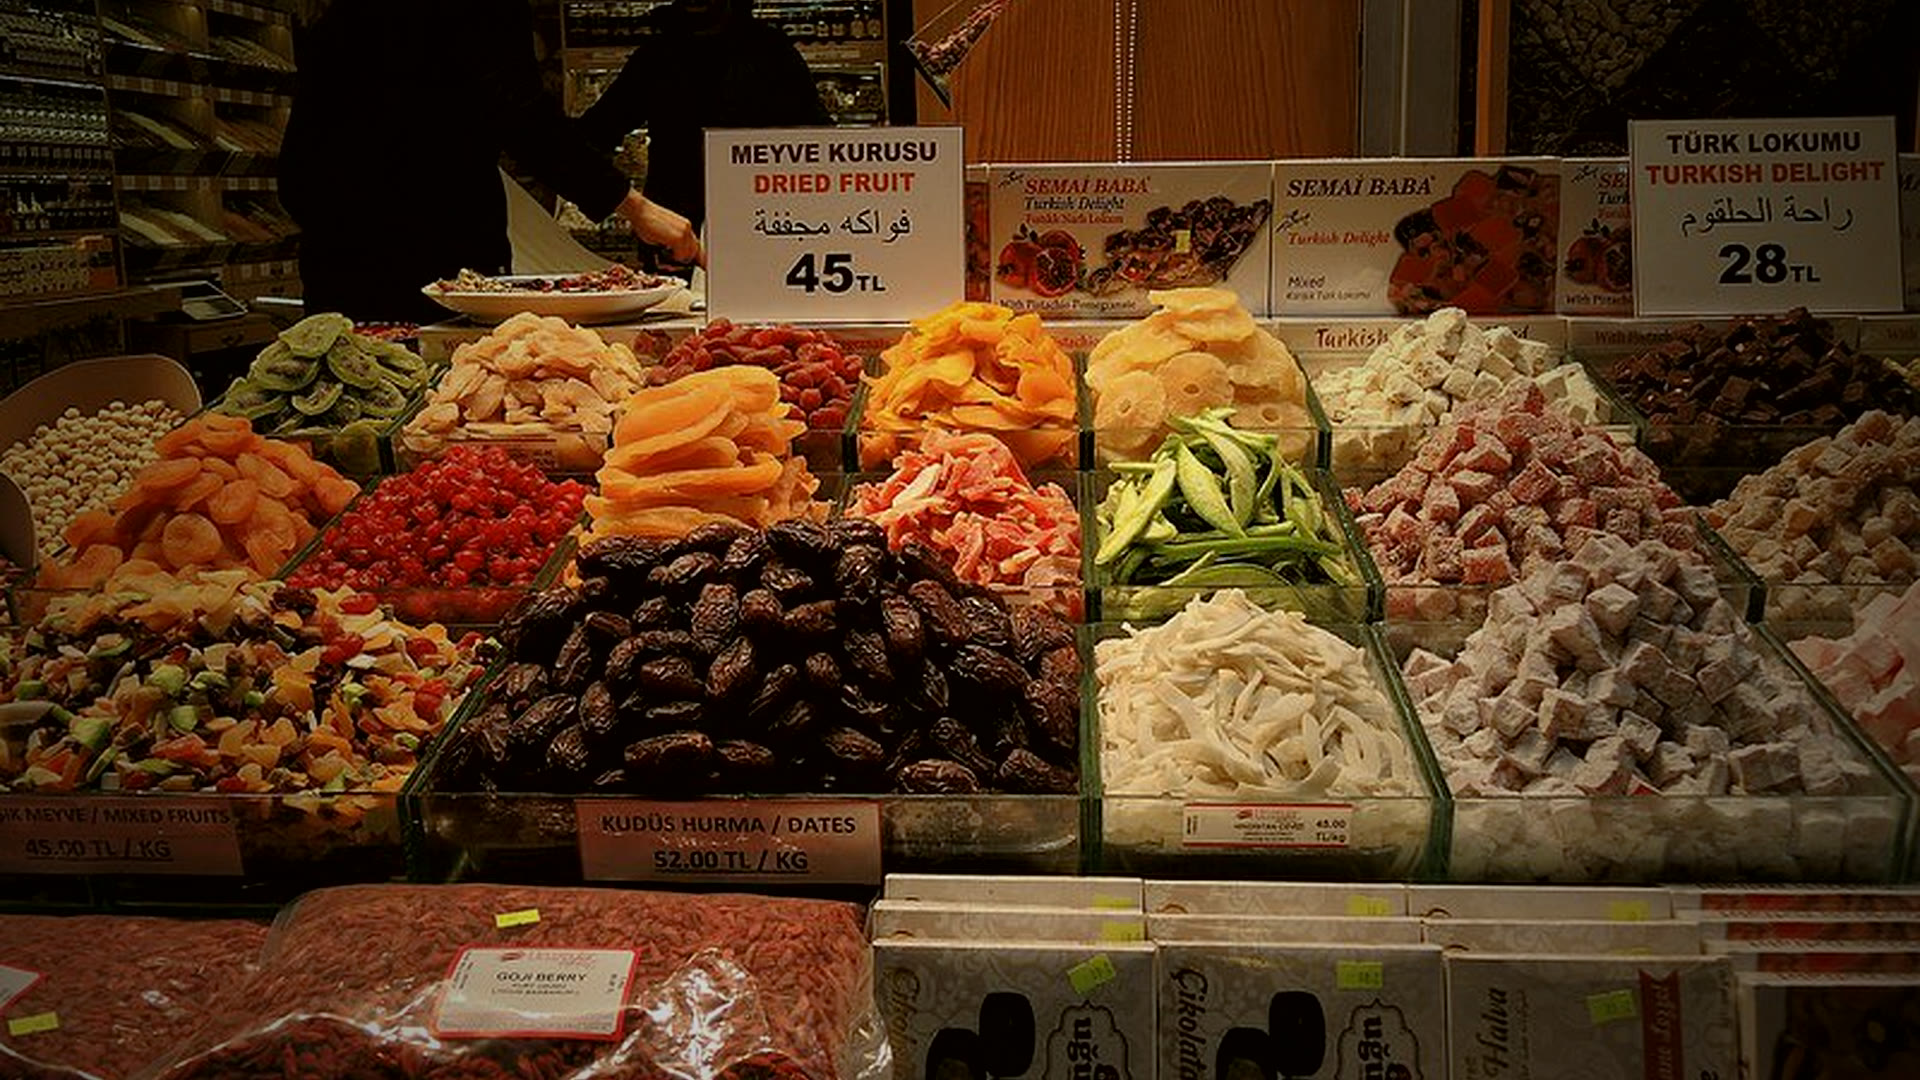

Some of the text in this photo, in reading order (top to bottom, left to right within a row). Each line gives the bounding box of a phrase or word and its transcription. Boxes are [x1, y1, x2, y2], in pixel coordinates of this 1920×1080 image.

[731, 141, 937, 164] MEYVE KURUSU
[1667, 130, 1861, 154] TÜRK LOKUMU
[754, 172, 915, 194] DRIED FRUIT
[1645, 164, 1763, 186] TURKISH
[1771, 161, 1886, 183] DELIGHT
[1094, 177, 1149, 193] BABA
[1369, 176, 1433, 196] BABA
[1024, 196, 1124, 212] Turkish Delight
[754, 208, 831, 242] مجففة
[1681, 195, 1853, 236] راحة الحلقوم
[1288, 231, 1390, 247] Turkish Delight
[1288, 275, 1325, 288] Mixed
[1316, 326, 1389, 349] Turkish
[25, 807, 89, 823] MEYVE
[103, 808, 163, 824] MIXED
[167, 808, 231, 825] FRUITS
[602, 813, 857, 836] KUDÜS HURMA / DATES
[25, 838, 86, 858] 45.00
[92, 838, 117, 857] TL
[139, 838, 172, 859] KG
[654, 849, 809, 872] 52.00 TL / KG
